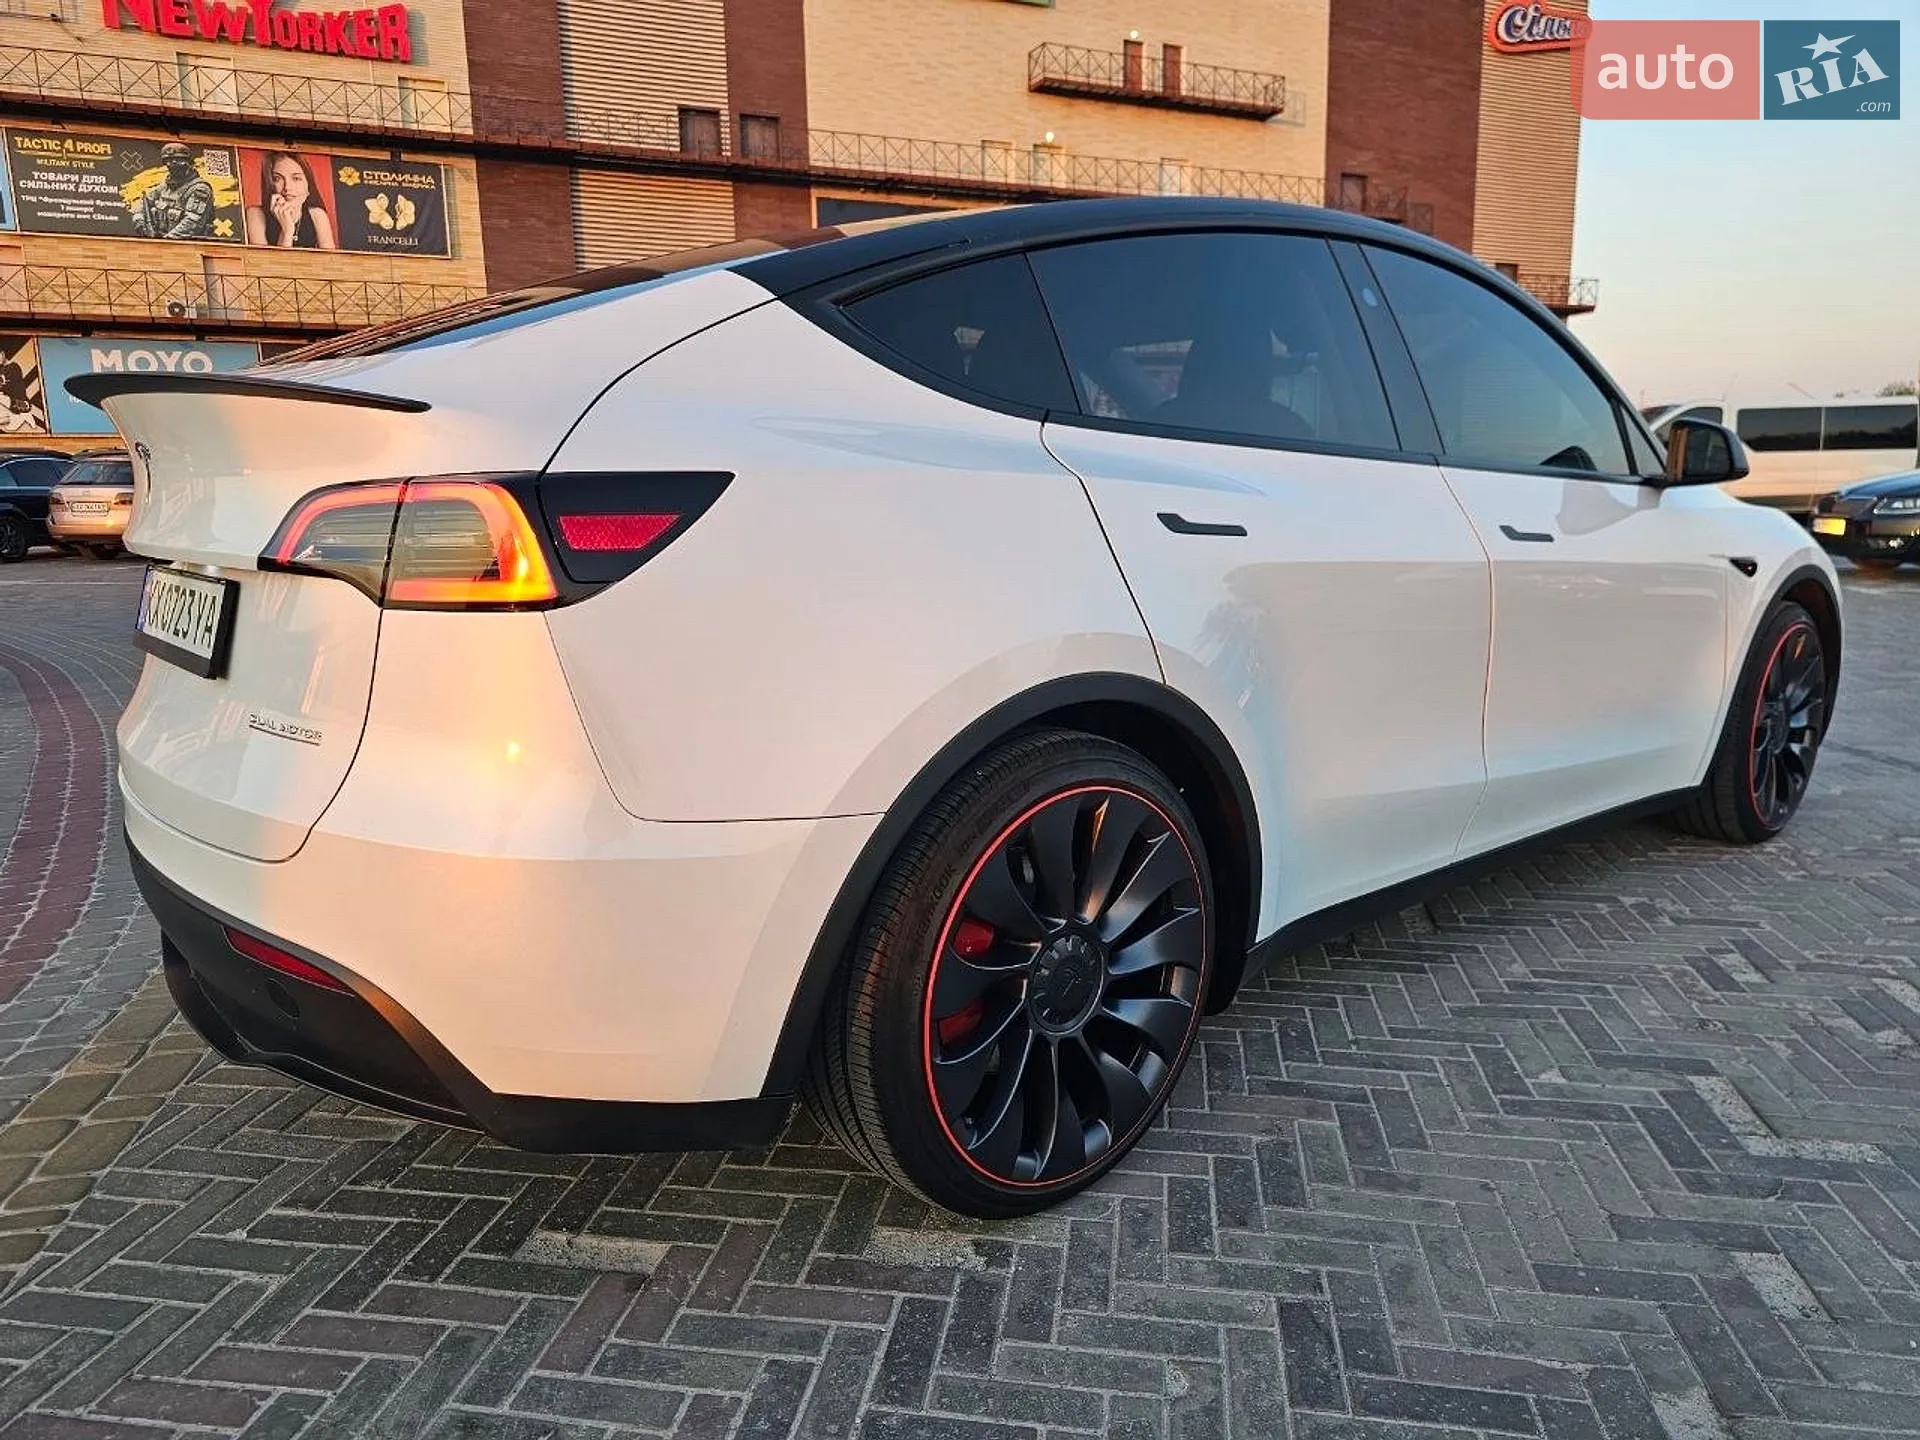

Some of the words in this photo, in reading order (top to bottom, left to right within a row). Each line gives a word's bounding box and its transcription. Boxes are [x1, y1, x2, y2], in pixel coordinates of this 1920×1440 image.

[14, 136, 61, 150] TACTIC
[63, 138, 74, 152] 4
[76, 141, 112, 154] PROFI
[32, 171, 79, 182] ТОВАРИ
[81, 174, 106, 184] ДЛЯ
[363, 171, 435, 184] СТОЛИЧНА
[19, 180, 76, 191] СИЛЬНИХ
[78, 183, 118, 194] ДУХОМ
[90, 348, 213, 373] MOYO
